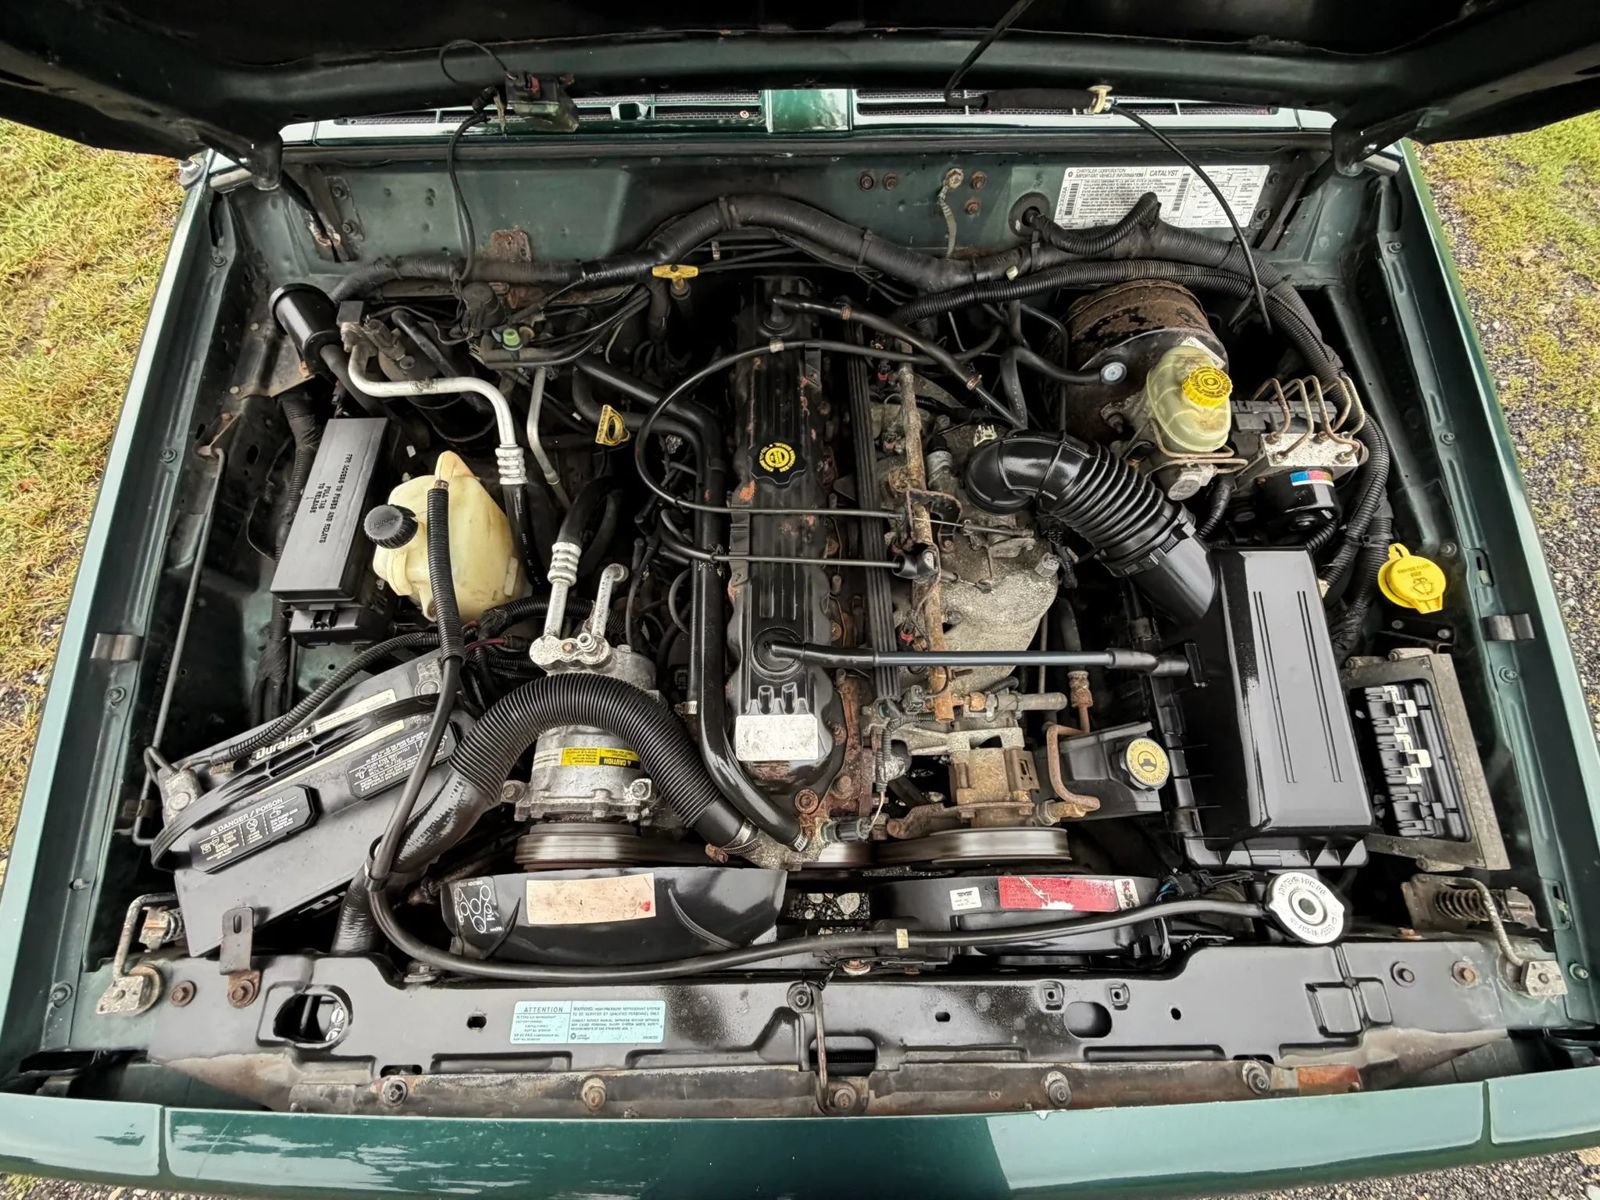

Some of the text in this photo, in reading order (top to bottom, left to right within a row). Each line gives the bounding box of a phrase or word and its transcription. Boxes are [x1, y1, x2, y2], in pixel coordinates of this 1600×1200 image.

[255, 727, 311, 759] Duralast
[604, 758, 626, 766] CAUTION
[217, 813, 249, 832] DANGER
[255, 797, 283, 814] POISON
